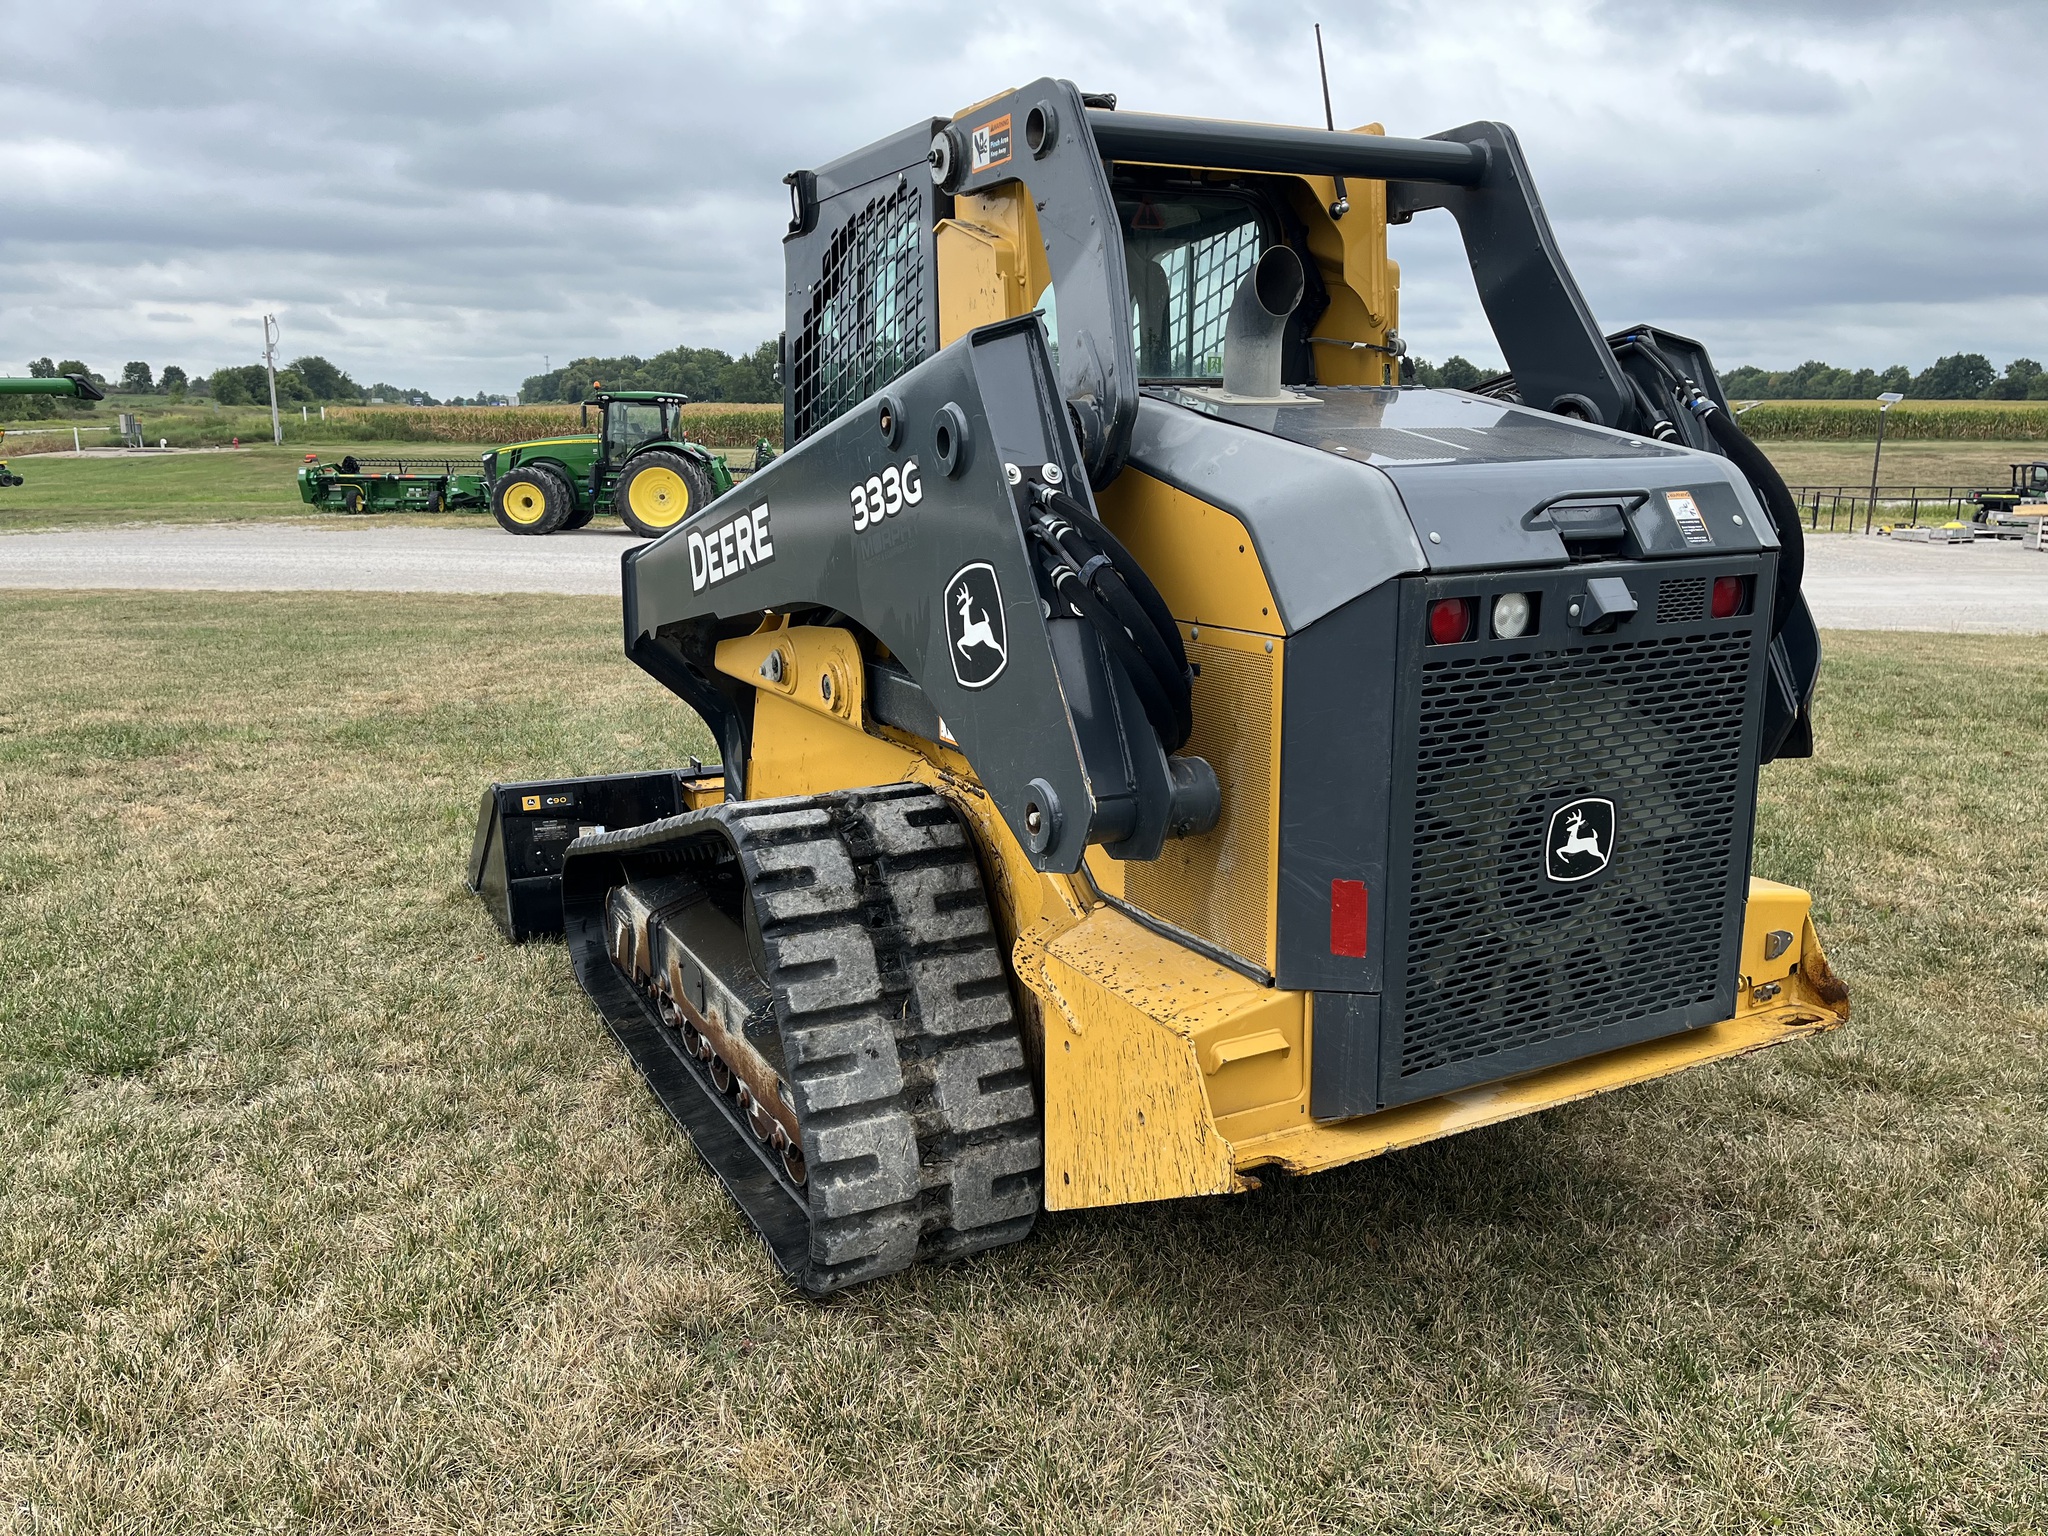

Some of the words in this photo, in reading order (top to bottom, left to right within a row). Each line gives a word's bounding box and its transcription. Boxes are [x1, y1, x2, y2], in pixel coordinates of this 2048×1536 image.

[850, 460, 923, 531] 333G
[687, 502, 774, 592] DEERE
[546, 796, 566, 804] C90
